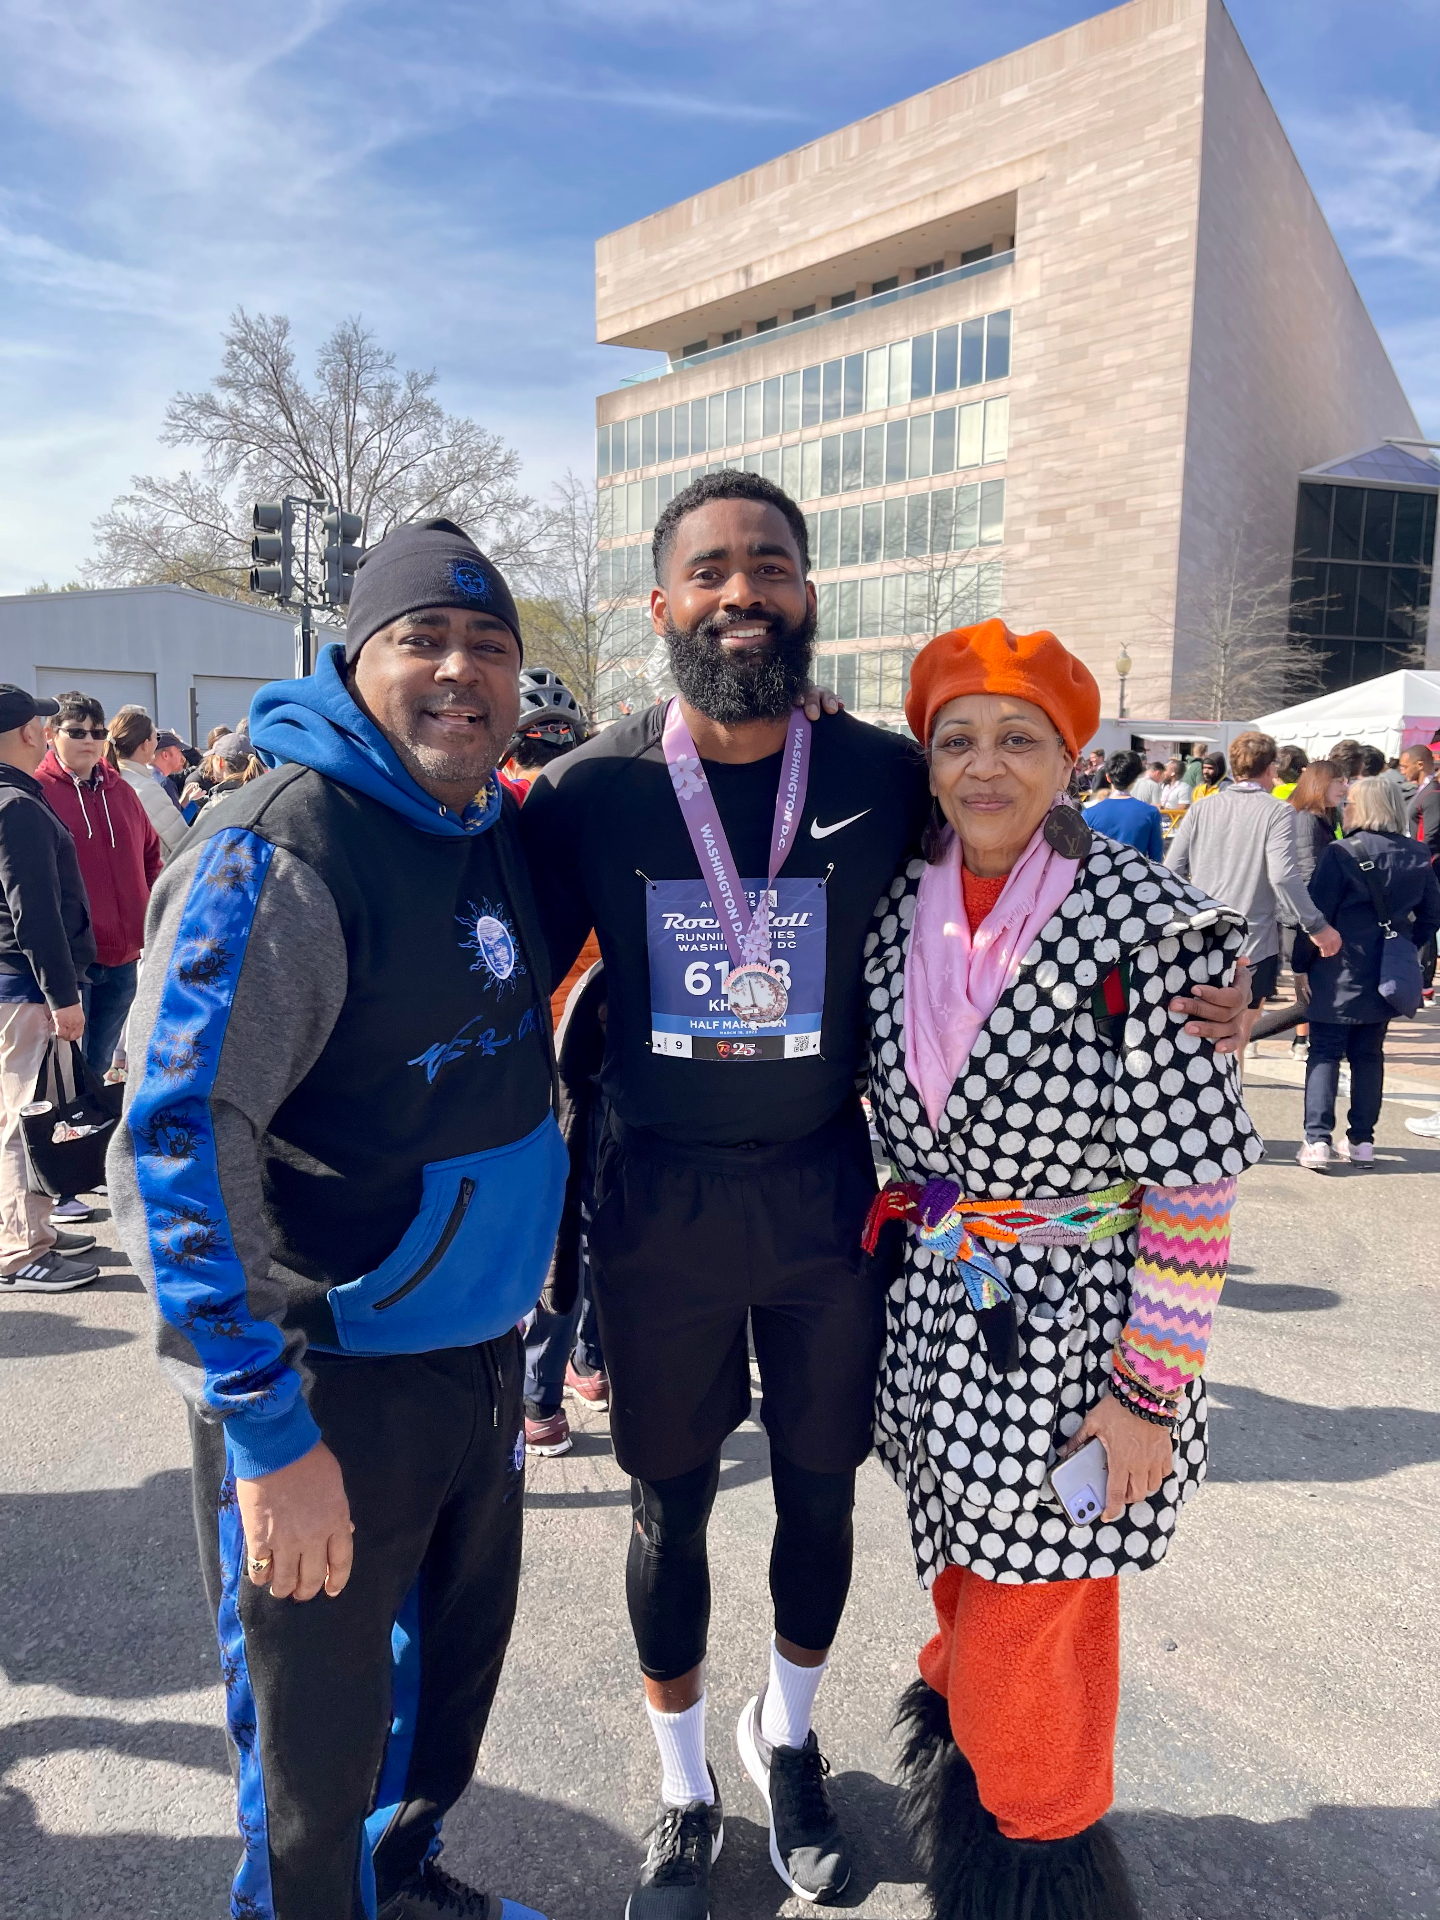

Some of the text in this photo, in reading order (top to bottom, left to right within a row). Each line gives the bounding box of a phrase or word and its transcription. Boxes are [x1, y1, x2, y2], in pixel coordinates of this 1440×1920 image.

[777, 728, 804, 851] WASHINGTON D.C.
[700, 823, 739, 920] WASHINGTON
[662, 913, 720, 929] Roc
[778, 941, 797, 949] DC
[684, 959, 792, 996] 618
[690, 1020, 719, 1030] HALF
[675, 1040, 683, 1050] 9
[733, 1042, 756, 1056] 25
